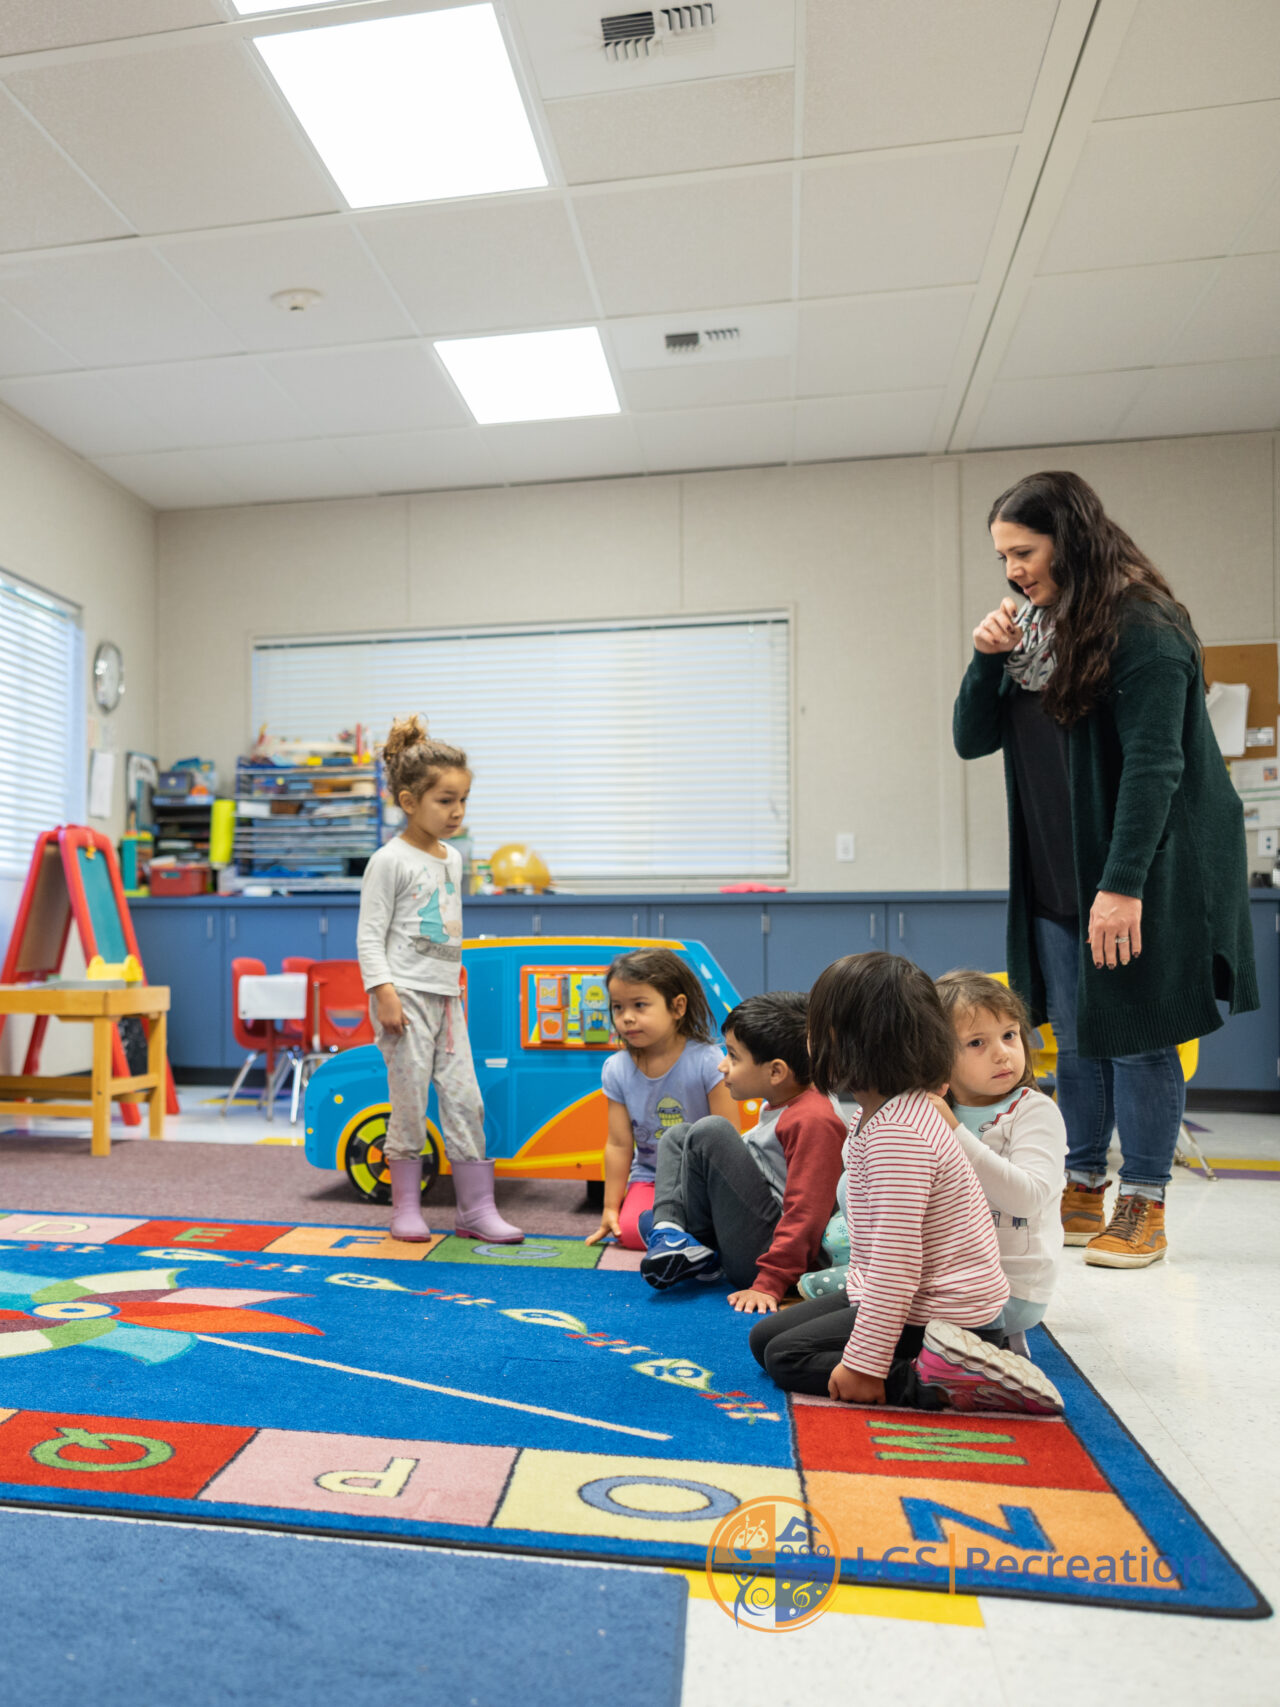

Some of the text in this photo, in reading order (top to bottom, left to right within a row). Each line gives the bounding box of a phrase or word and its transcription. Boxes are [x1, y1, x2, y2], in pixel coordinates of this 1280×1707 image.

[14, 1220, 90, 1234] D
[170, 1226, 235, 1242] E
[329, 1235, 386, 1249] F
[471, 1243, 562, 1260] G
[338, 1276, 379, 1285] 8
[643, 1364, 704, 1380] 10
[28, 1427, 177, 1473] Q
[313, 1456, 421, 1498] P
[577, 1474, 741, 1522] O
[899, 1495, 1056, 1553] N
